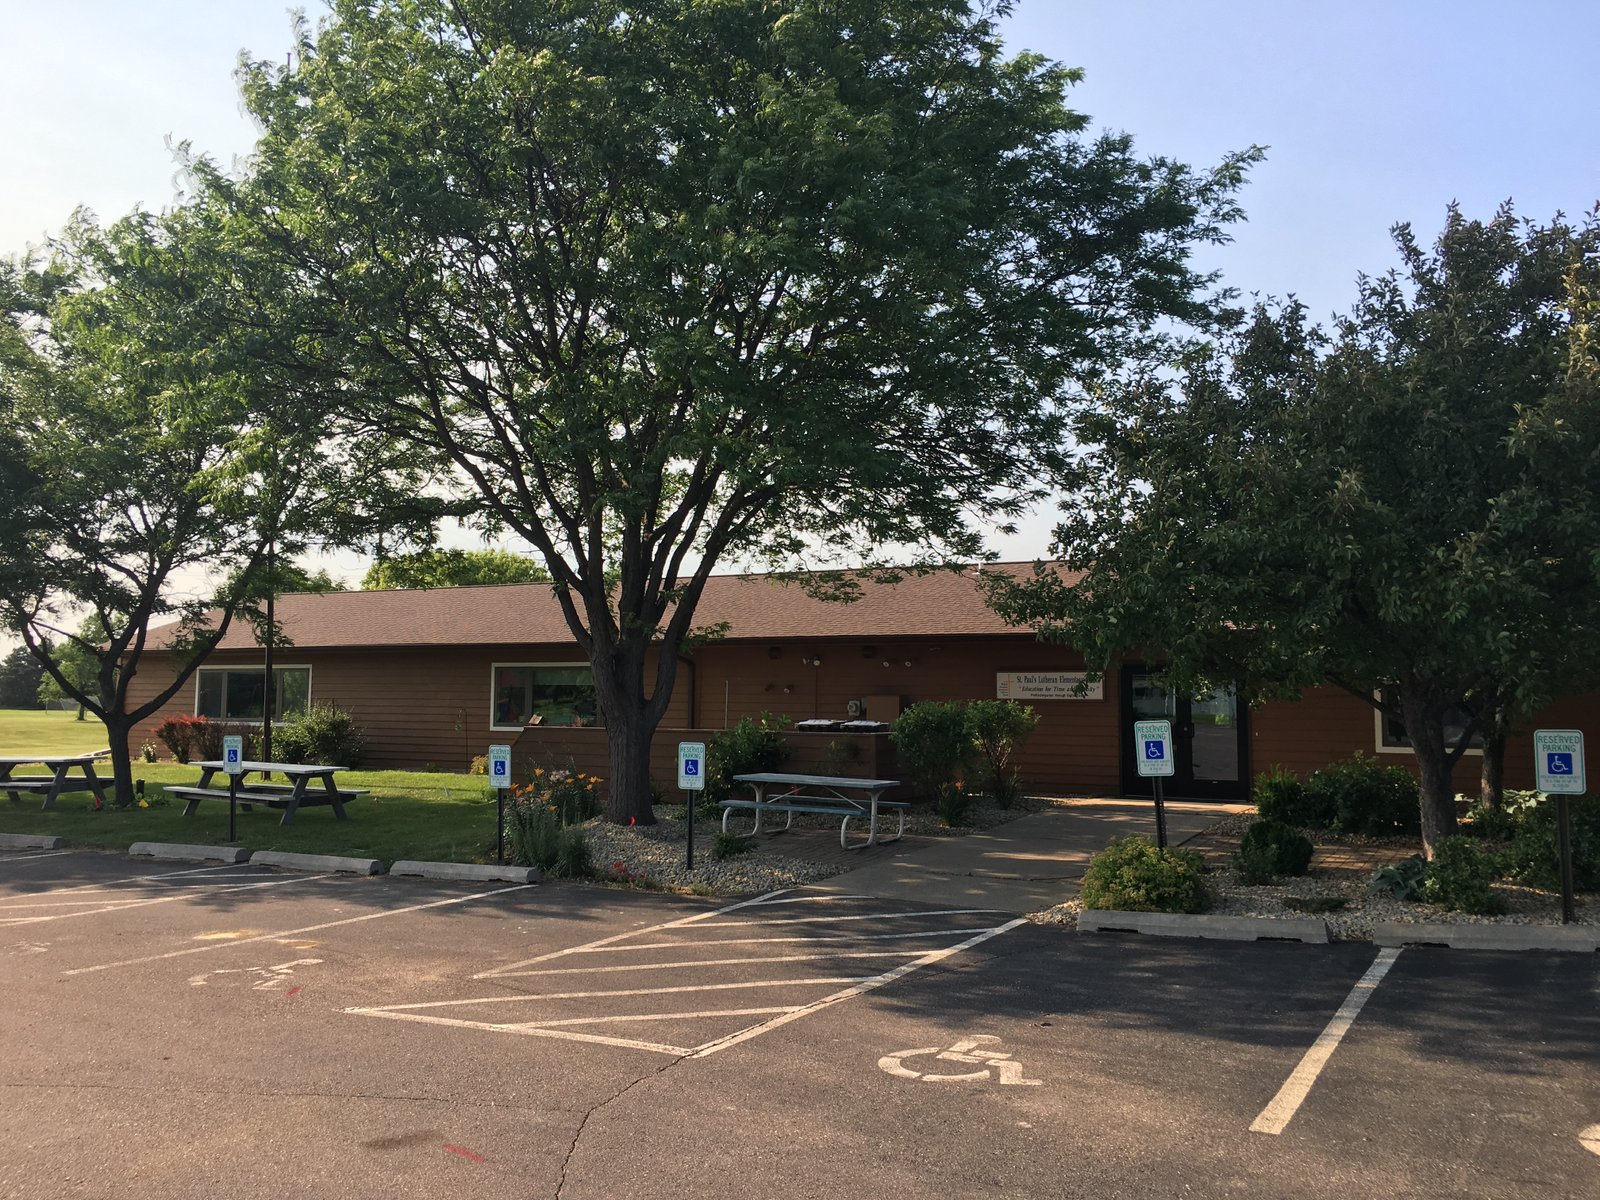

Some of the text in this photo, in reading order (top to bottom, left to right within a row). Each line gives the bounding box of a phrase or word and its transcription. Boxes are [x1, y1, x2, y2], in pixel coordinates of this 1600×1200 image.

[1024, 675, 1037, 684] Paul's
[1038, 675, 1058, 684] Lutheran
[1136, 725, 1169, 733] RESERVED
[1537, 735, 1580, 744] RESERVED
[1542, 744, 1576, 753] PARKING
[682, 752, 702, 760] PARKING
